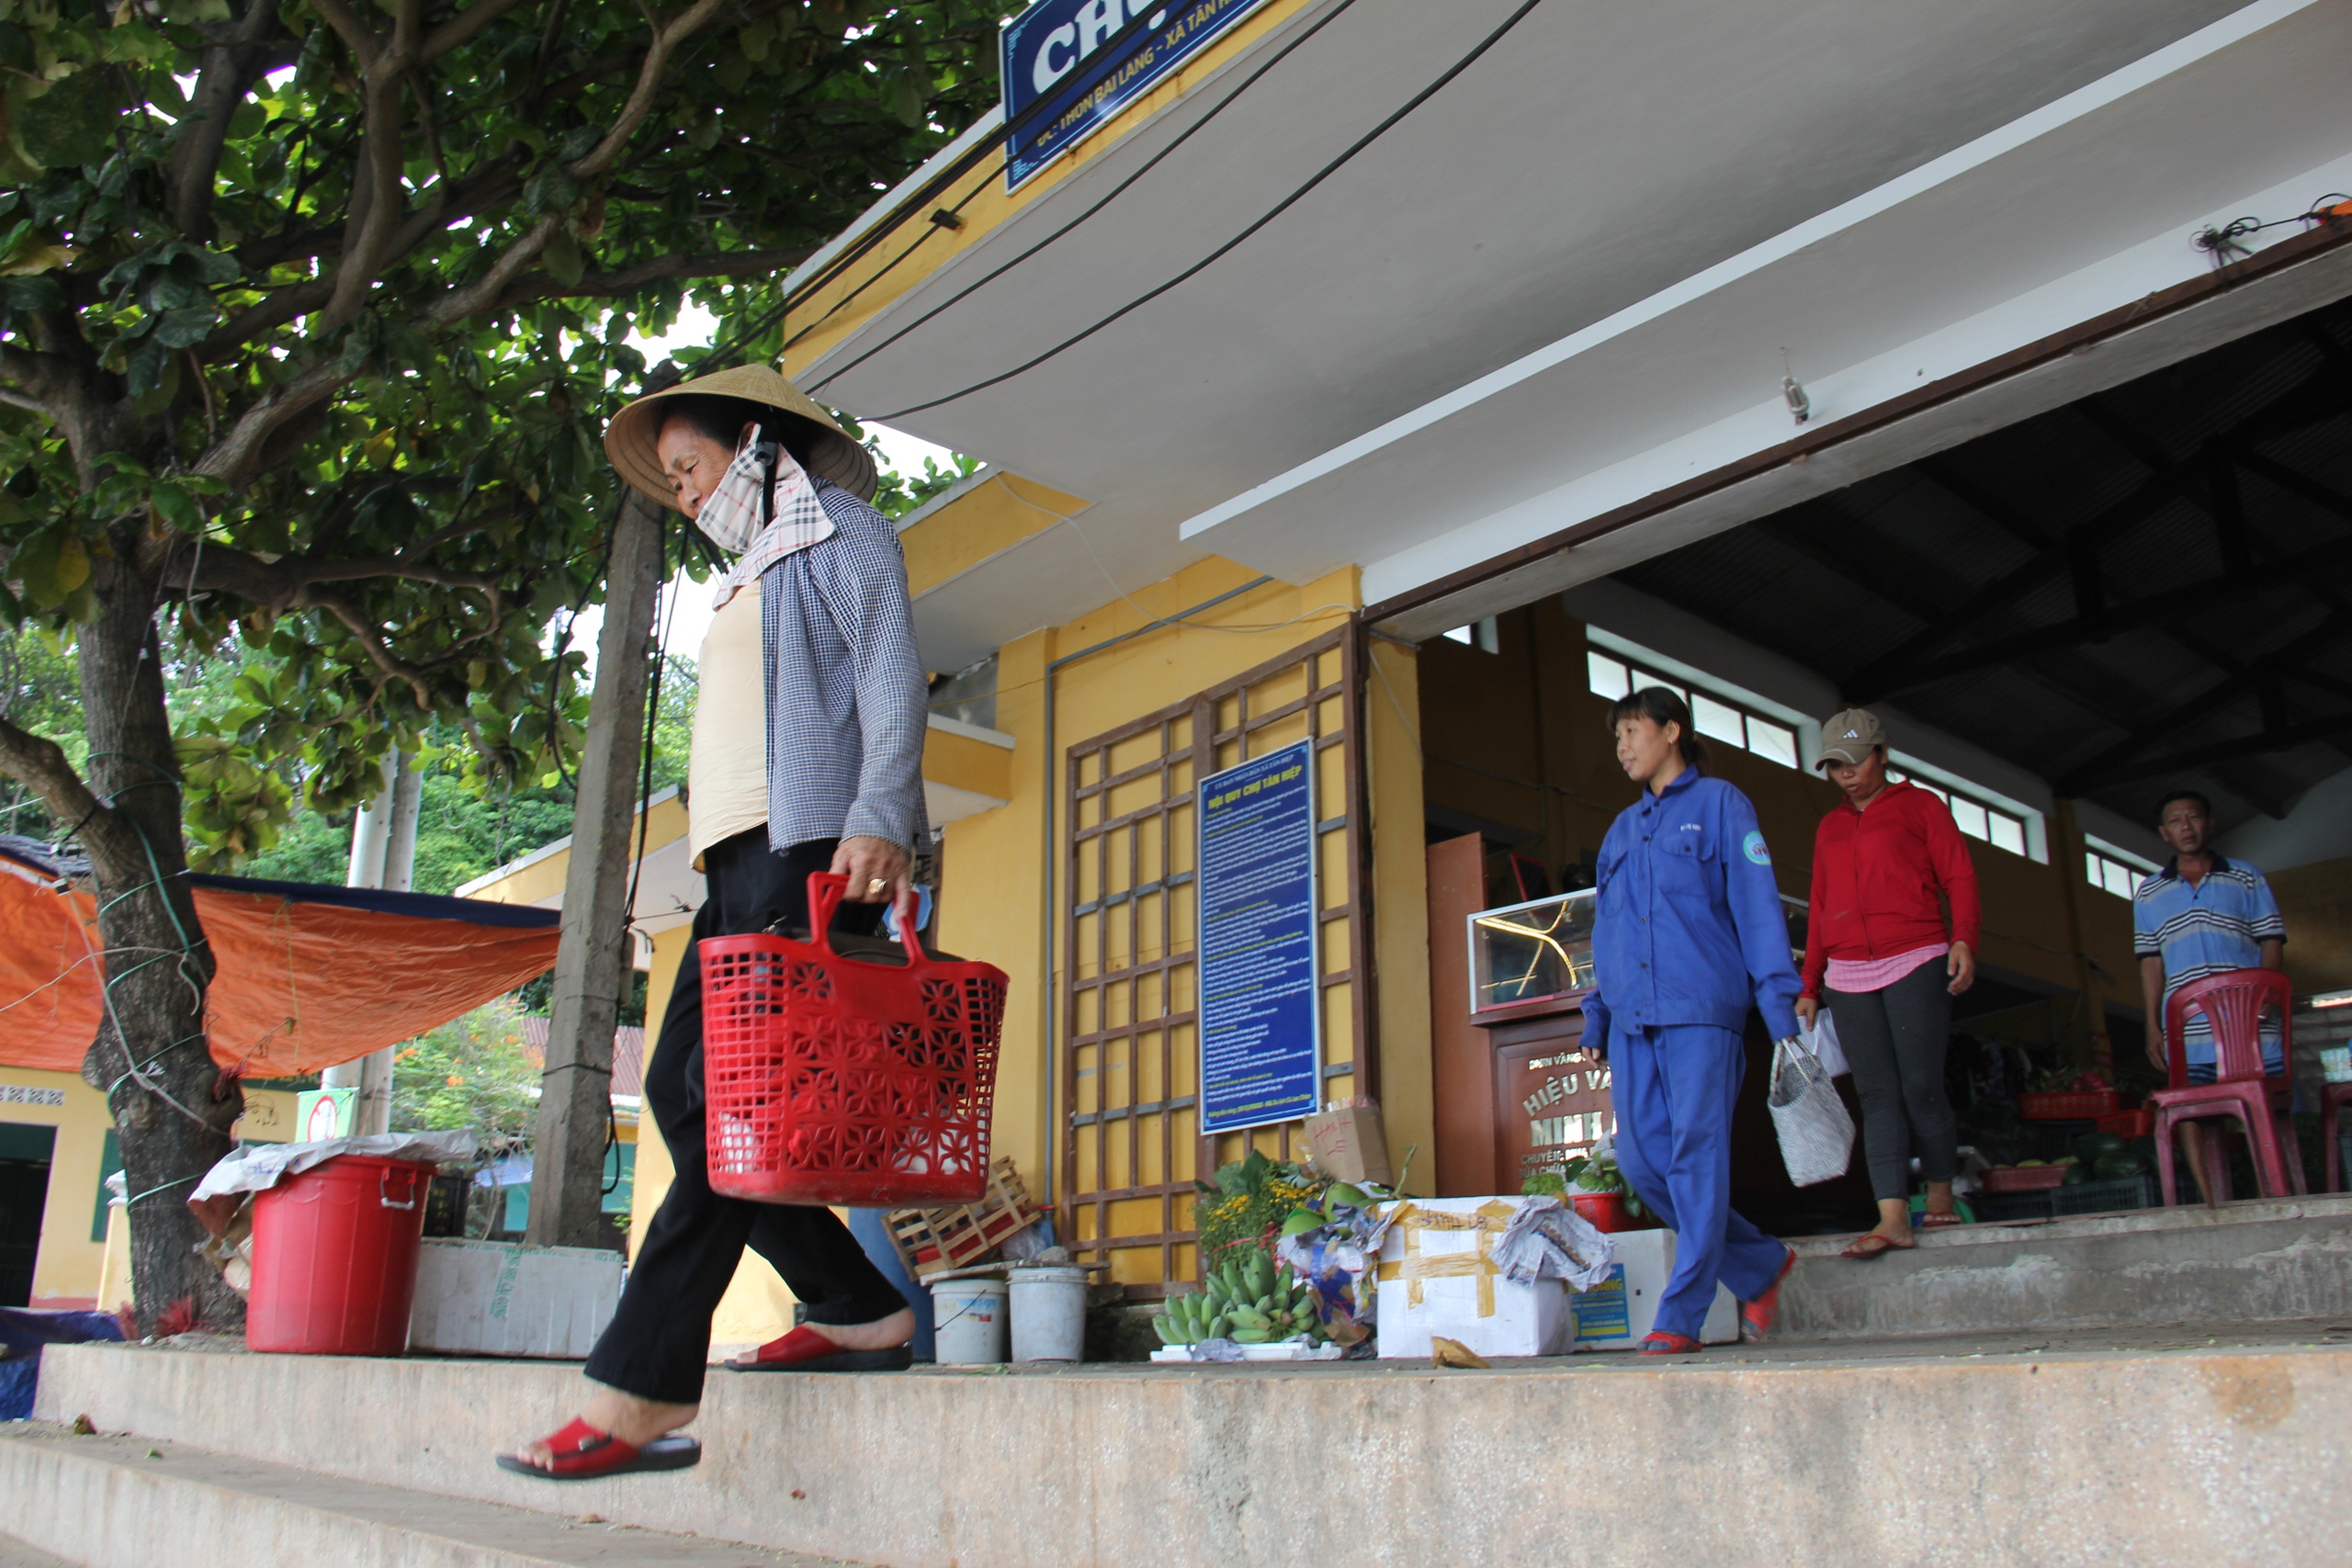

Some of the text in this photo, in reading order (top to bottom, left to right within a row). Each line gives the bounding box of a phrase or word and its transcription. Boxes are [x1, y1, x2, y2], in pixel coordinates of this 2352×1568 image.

[1186, 0, 1217, 32] TÂN
[1522, 1065, 1612, 1117] HIỆU VÀ
[1531, 1111, 1603, 1147] MINH
